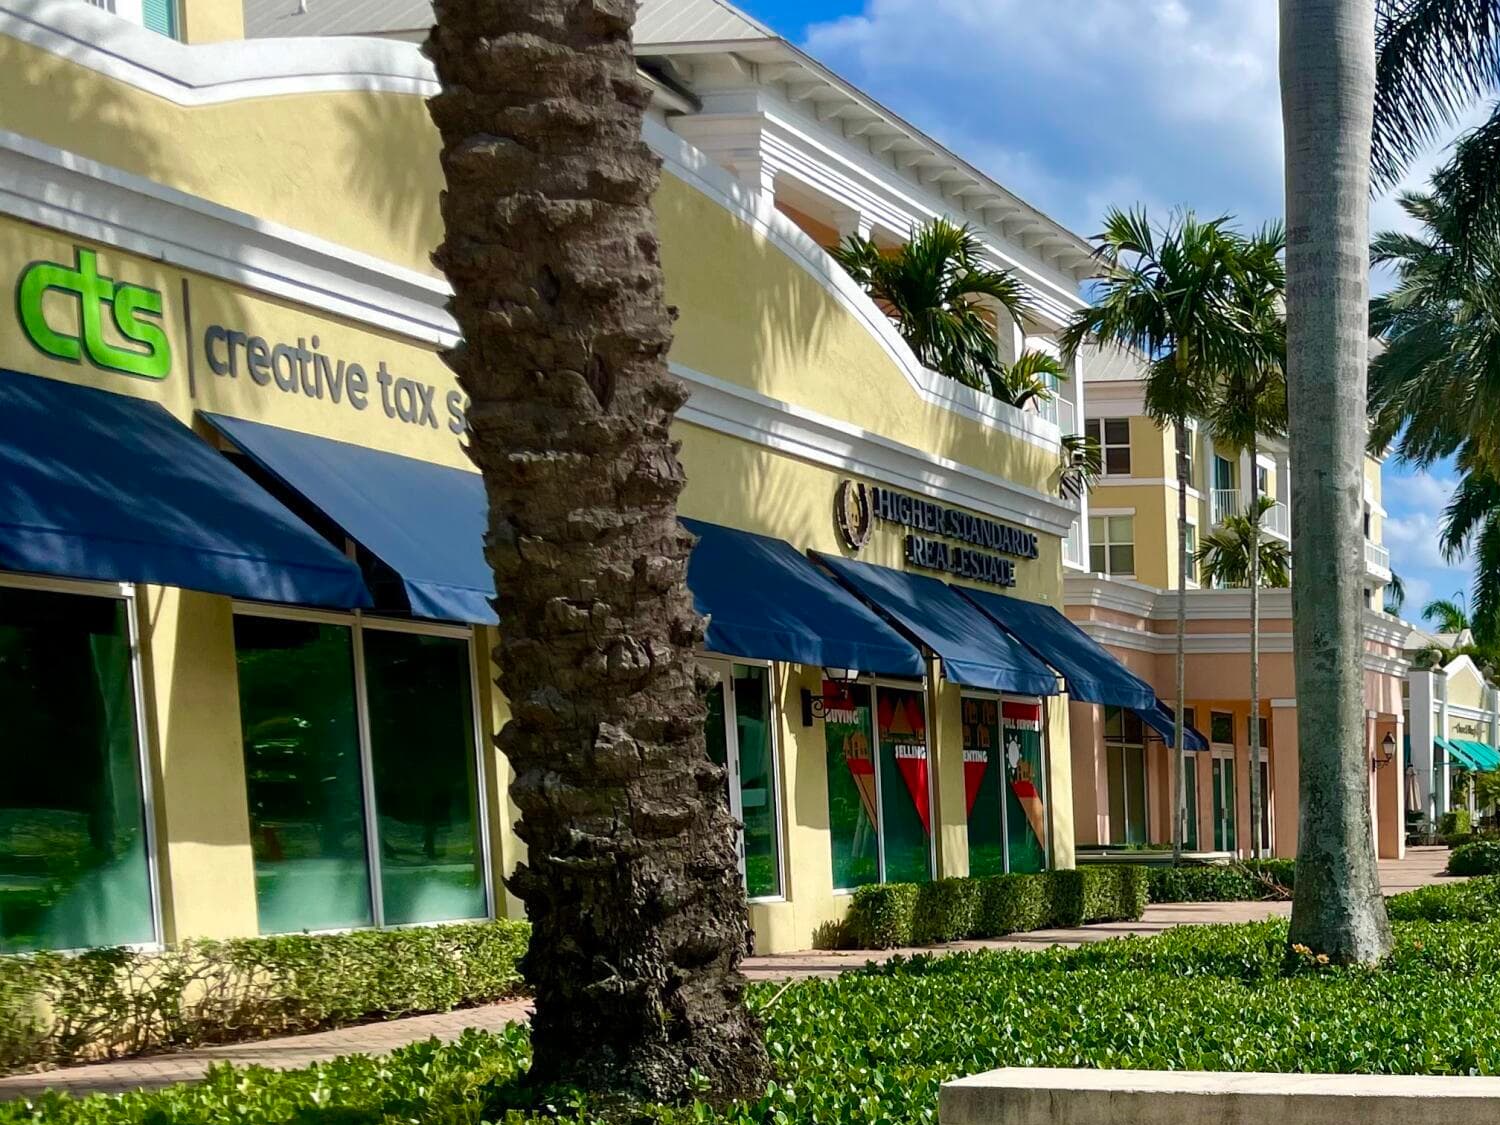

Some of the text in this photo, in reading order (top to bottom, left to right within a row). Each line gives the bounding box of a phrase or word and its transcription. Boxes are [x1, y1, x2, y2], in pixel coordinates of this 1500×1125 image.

[18, 246, 171, 379] cts
[205, 323, 368, 410] creative
[377, 361, 440, 429] tax
[874, 487, 1039, 559] HIGHER STANDARDS
[908, 535, 1016, 587] REAL ESTATE
[962, 749, 988, 762] ENTING
